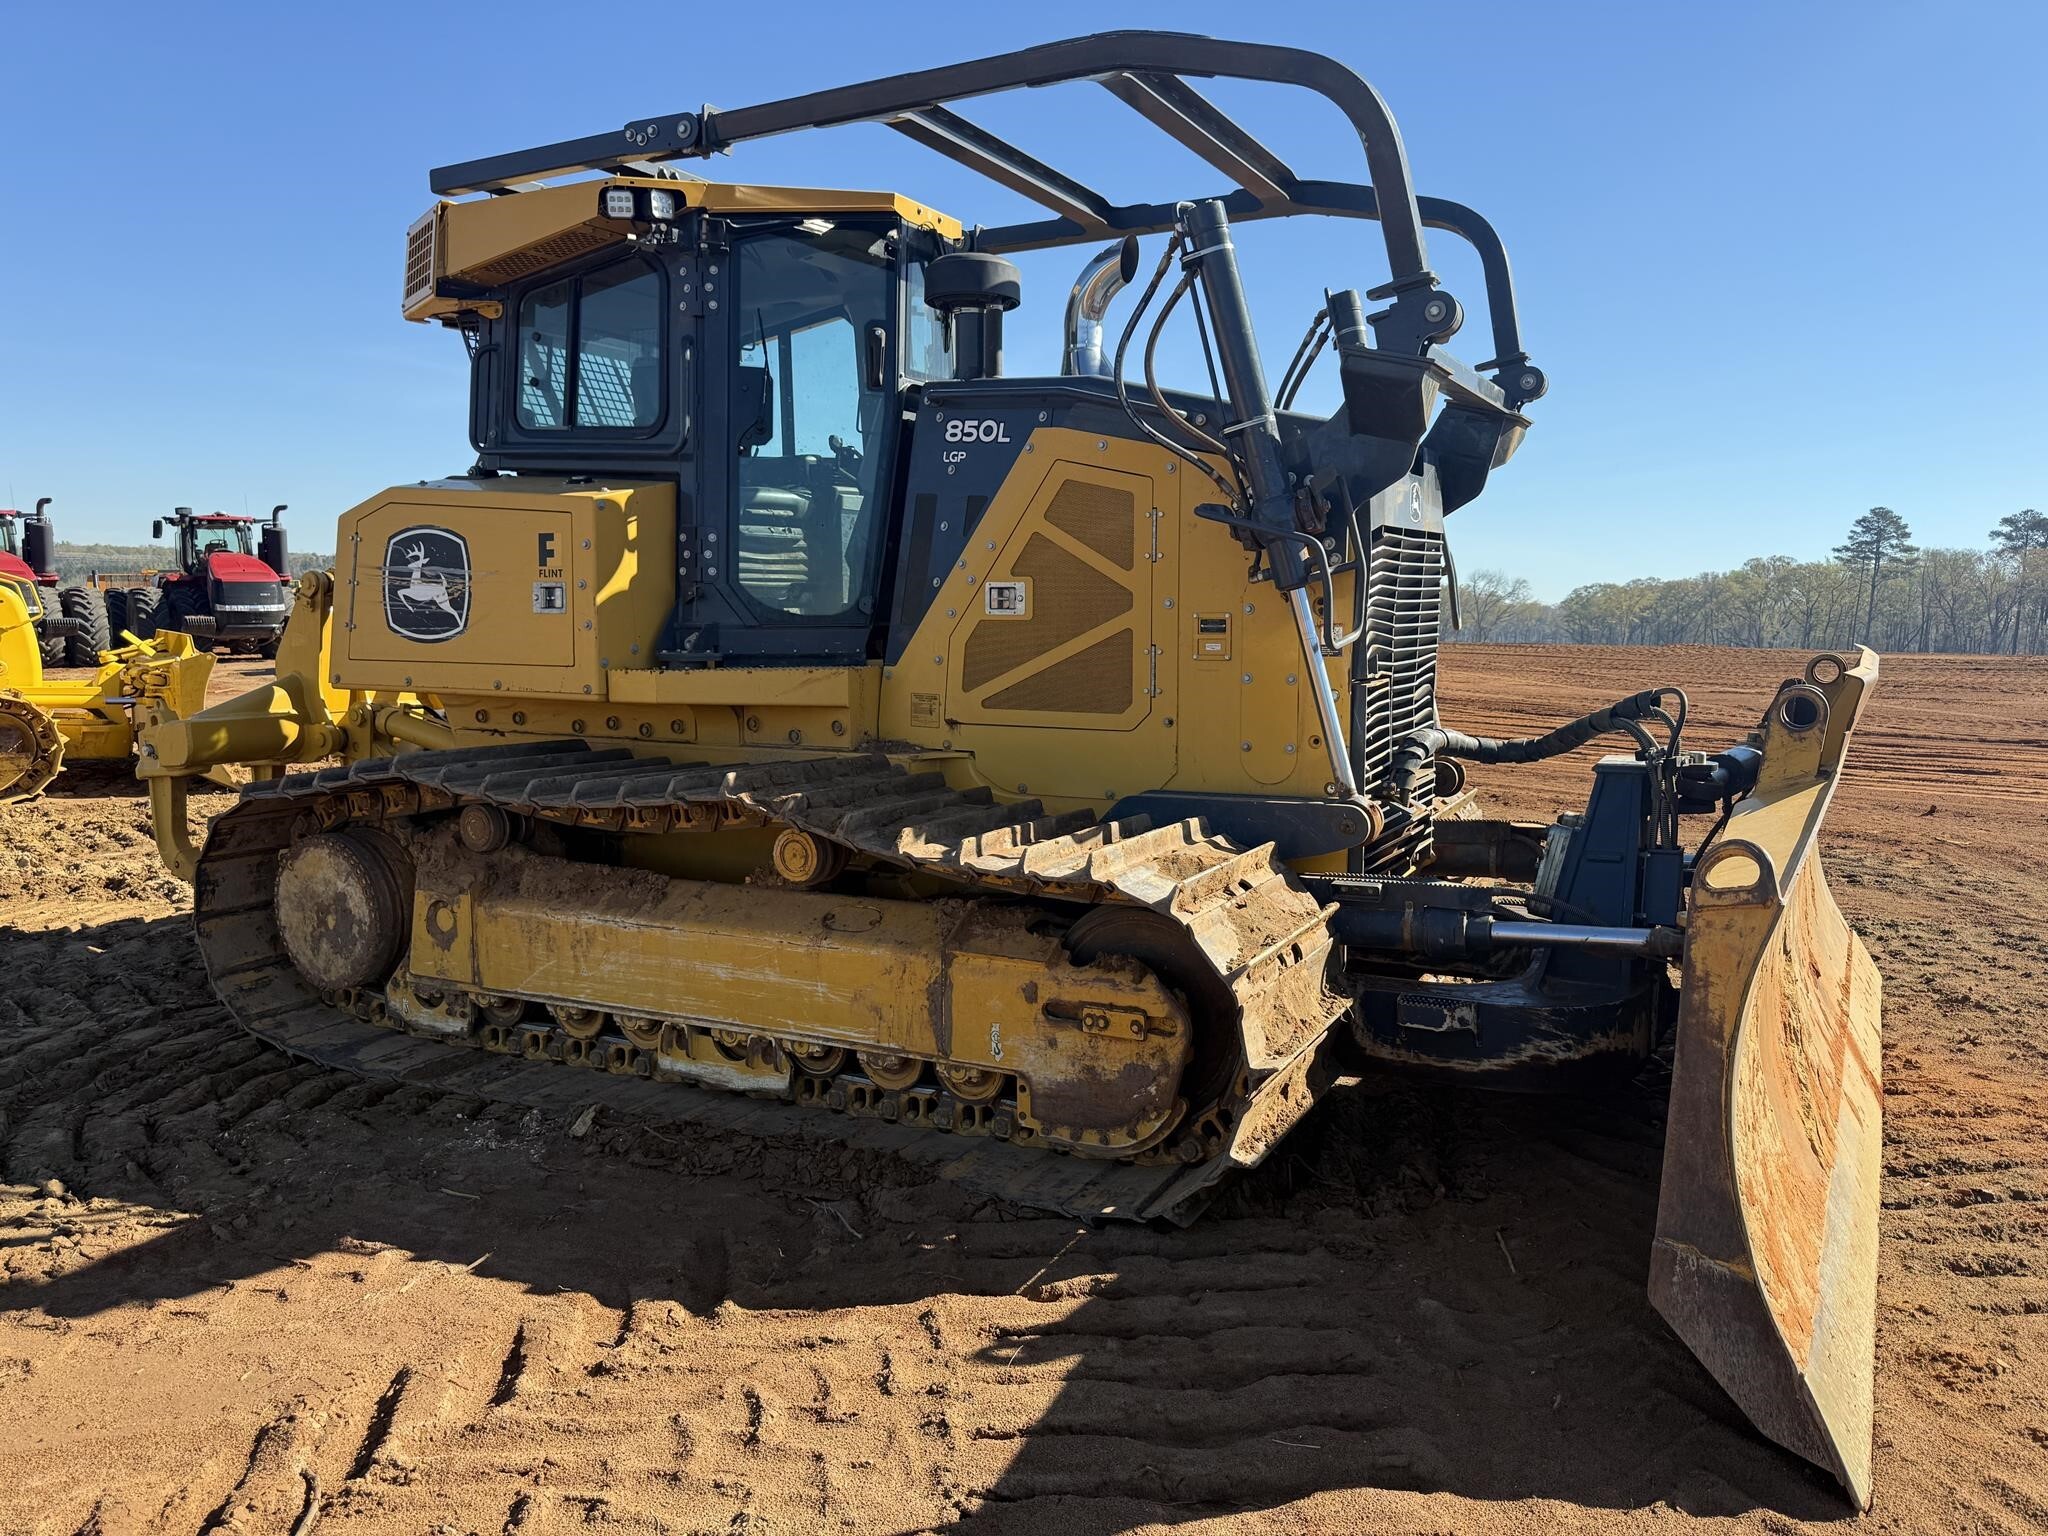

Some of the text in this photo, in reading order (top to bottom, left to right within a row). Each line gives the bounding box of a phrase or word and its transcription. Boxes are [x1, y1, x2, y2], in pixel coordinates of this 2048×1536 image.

[944, 419, 1011, 443] 850L
[942, 451, 967, 463] LGP
[538, 532, 555, 567] F
[538, 568, 564, 578] FLINT
